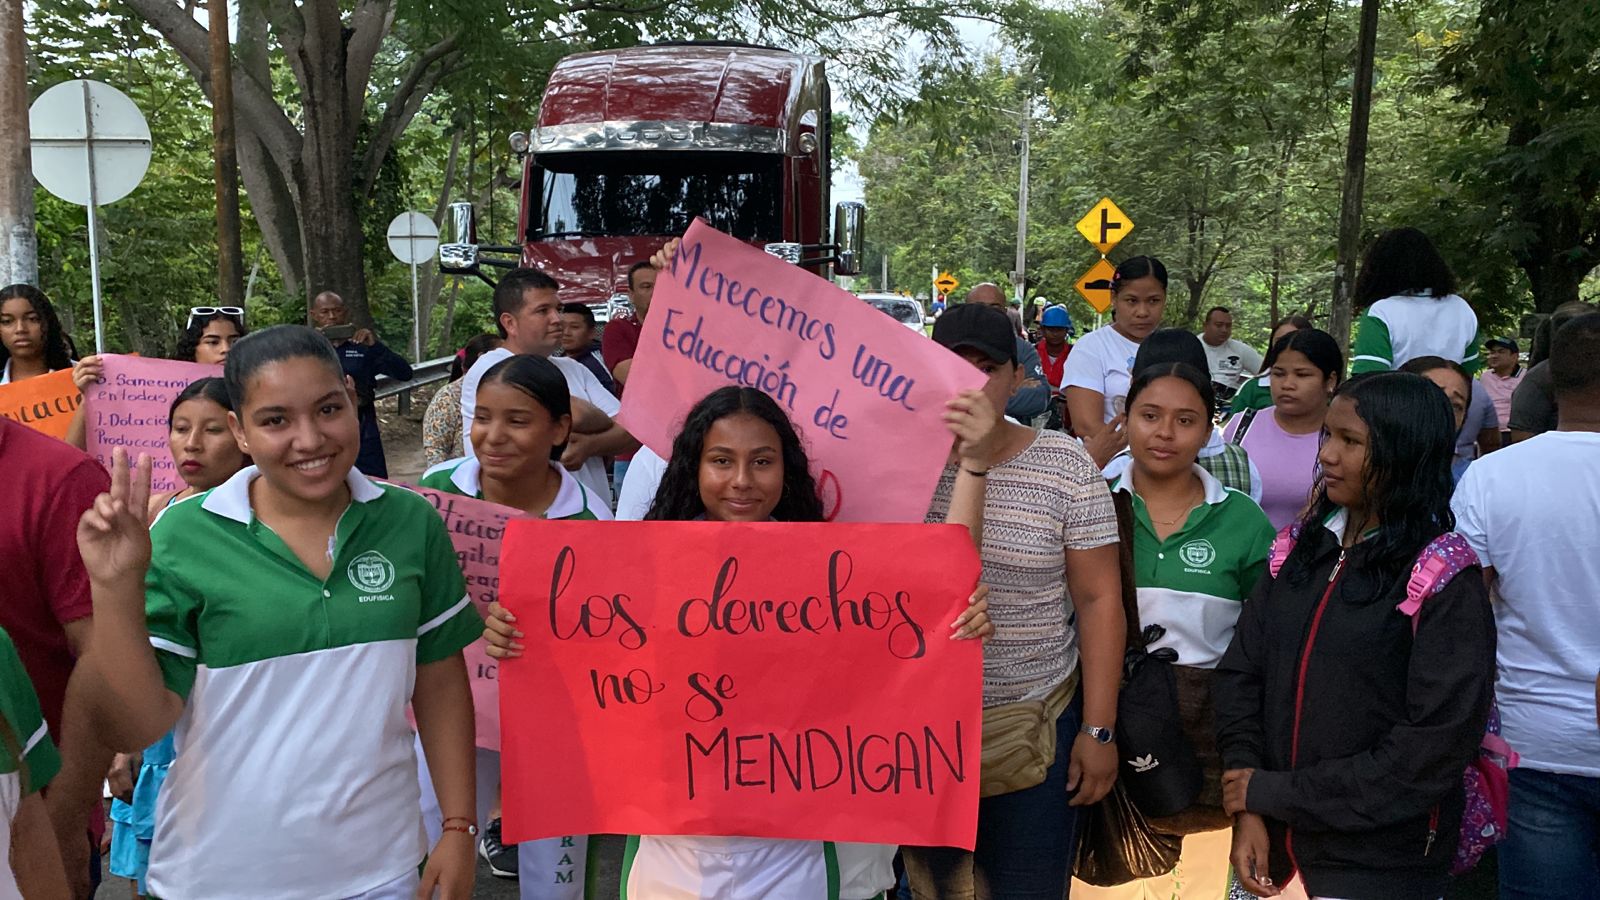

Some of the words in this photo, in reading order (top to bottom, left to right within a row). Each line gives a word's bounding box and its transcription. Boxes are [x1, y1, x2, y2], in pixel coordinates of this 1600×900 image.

[662, 308, 798, 410] Educación
[814, 389, 849, 440] de
[670, 242, 836, 360] Merecemos
[852, 345, 915, 411] una
[98, 391, 117, 401] en
[549, 546, 648, 650] los
[677, 549, 927, 660] derechos
[590, 667, 666, 710] no
[685, 670, 738, 723] se
[684, 720, 967, 801] MENDIGAN
